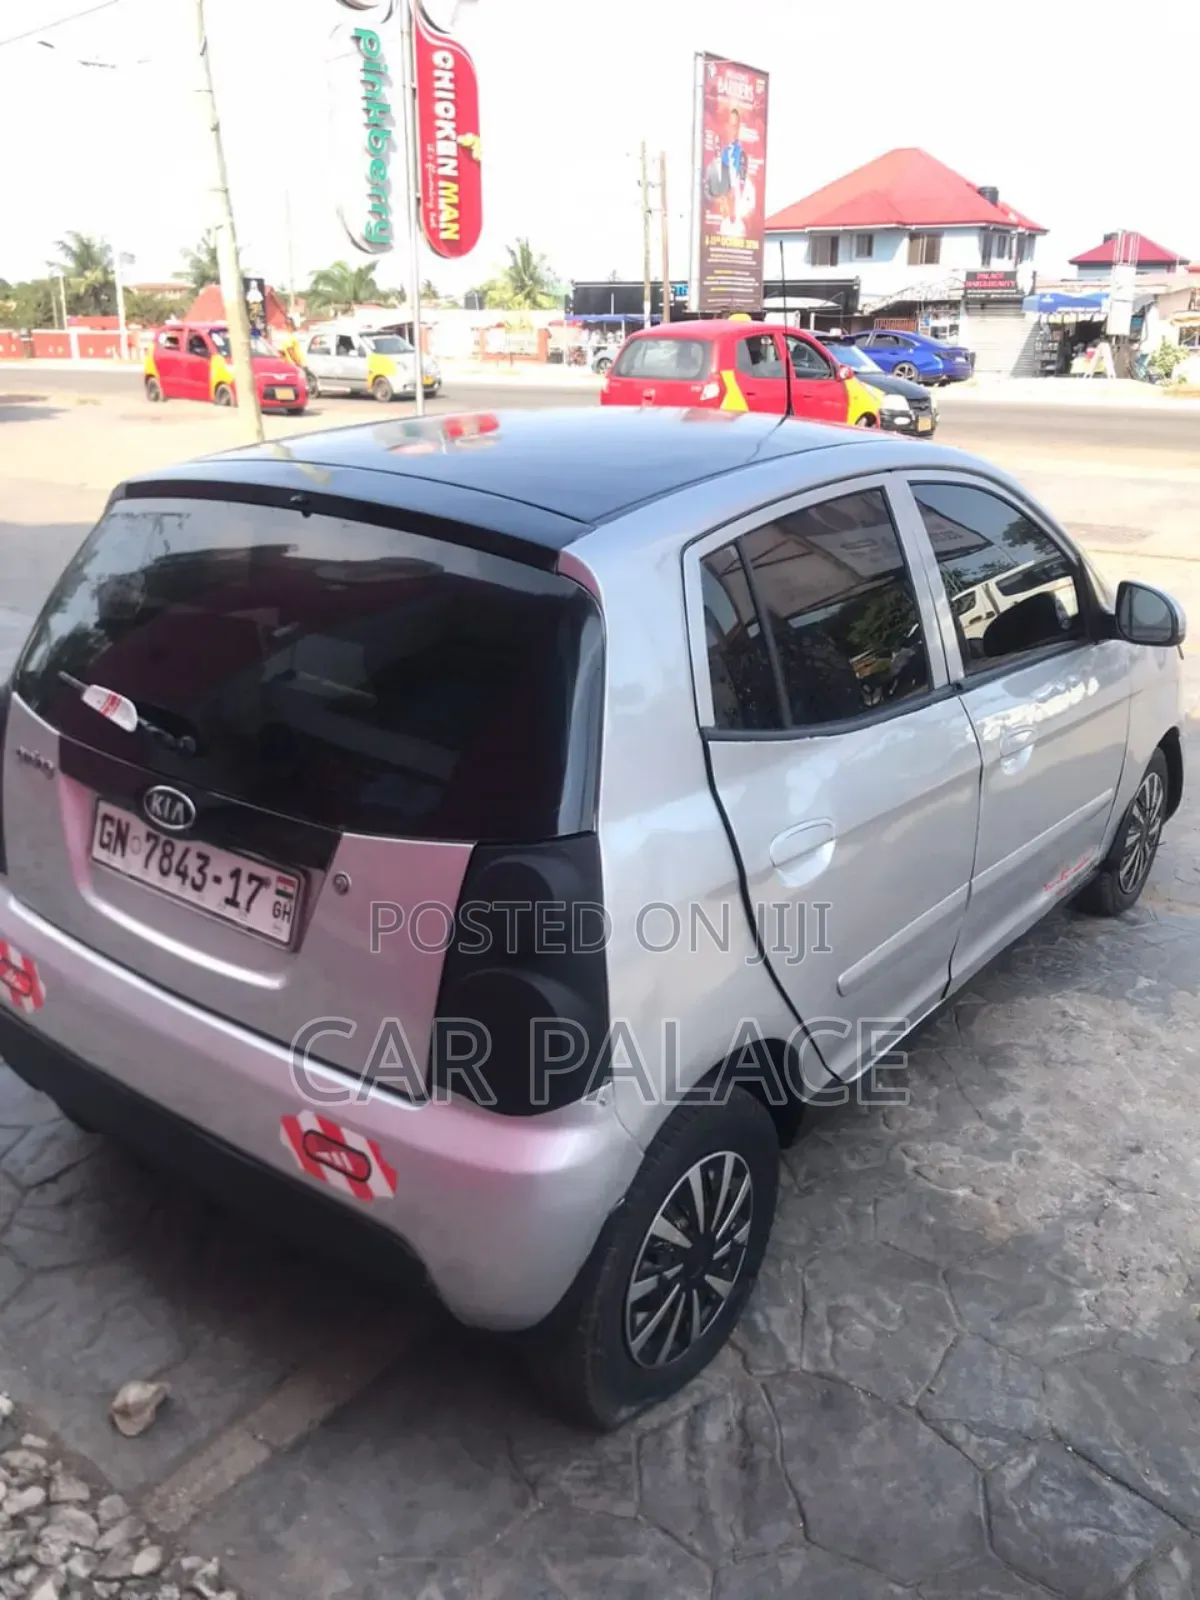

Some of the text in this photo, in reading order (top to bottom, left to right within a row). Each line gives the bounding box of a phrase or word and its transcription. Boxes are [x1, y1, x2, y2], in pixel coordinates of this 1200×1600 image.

[353, 28, 392, 244] pinkberry
[438, 180, 460, 240] MAN
[151, 793, 185, 824] KIA
[98, 813, 267, 914] GN 7843-17
[272, 900, 292, 924] GH
